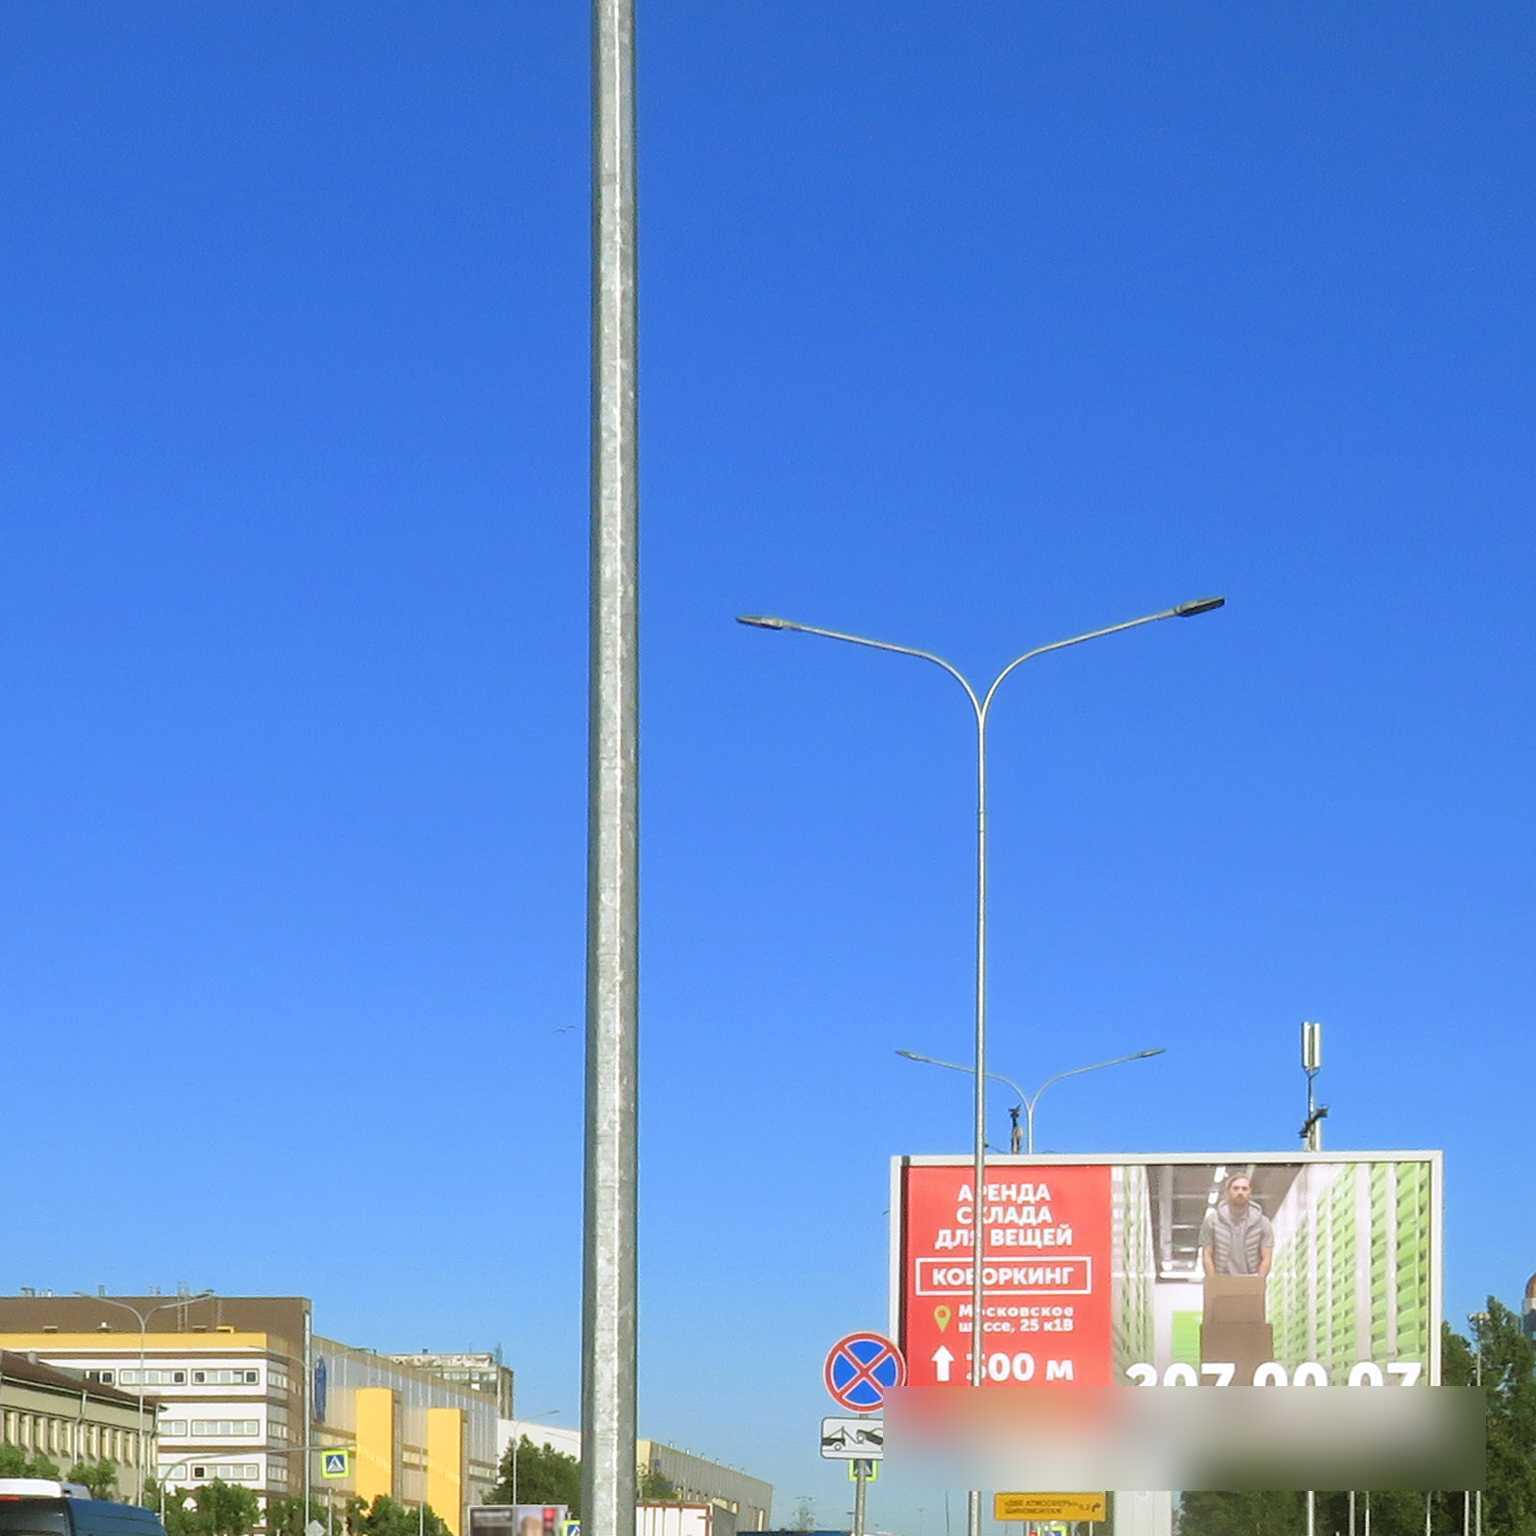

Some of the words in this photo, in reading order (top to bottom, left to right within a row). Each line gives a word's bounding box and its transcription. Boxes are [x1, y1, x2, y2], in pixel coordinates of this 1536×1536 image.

[958, 1183, 1051, 1204] АЕНДА
[990, 1223, 1073, 1249] ВЕЩЕЙ
[958, 1303, 1074, 1317] Мсковское
[958, 1321, 1016, 1334] шссе,
[1020, 1319, 1040, 1332] 25
